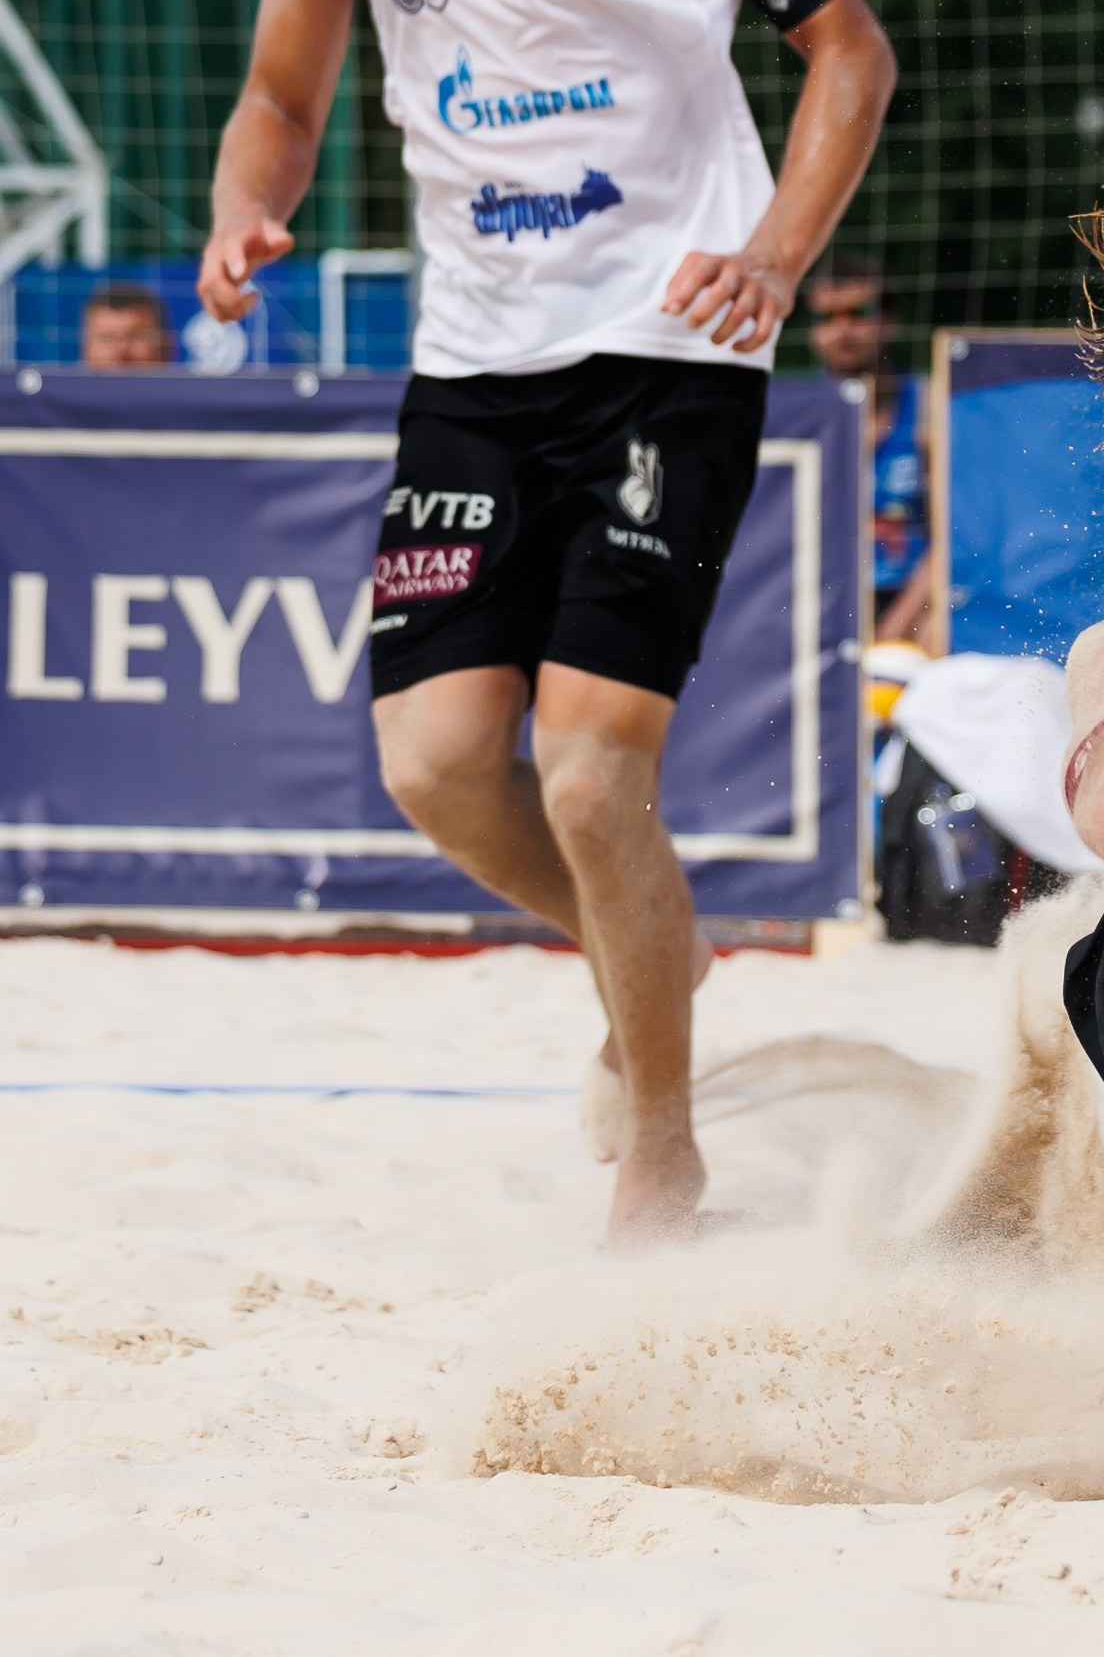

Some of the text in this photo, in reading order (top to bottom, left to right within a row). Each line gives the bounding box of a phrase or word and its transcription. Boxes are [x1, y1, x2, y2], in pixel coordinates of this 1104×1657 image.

[410, 491, 495, 530] VTB
[375, 547, 473, 588] QATAR
[7, 571, 374, 704] LEYV
